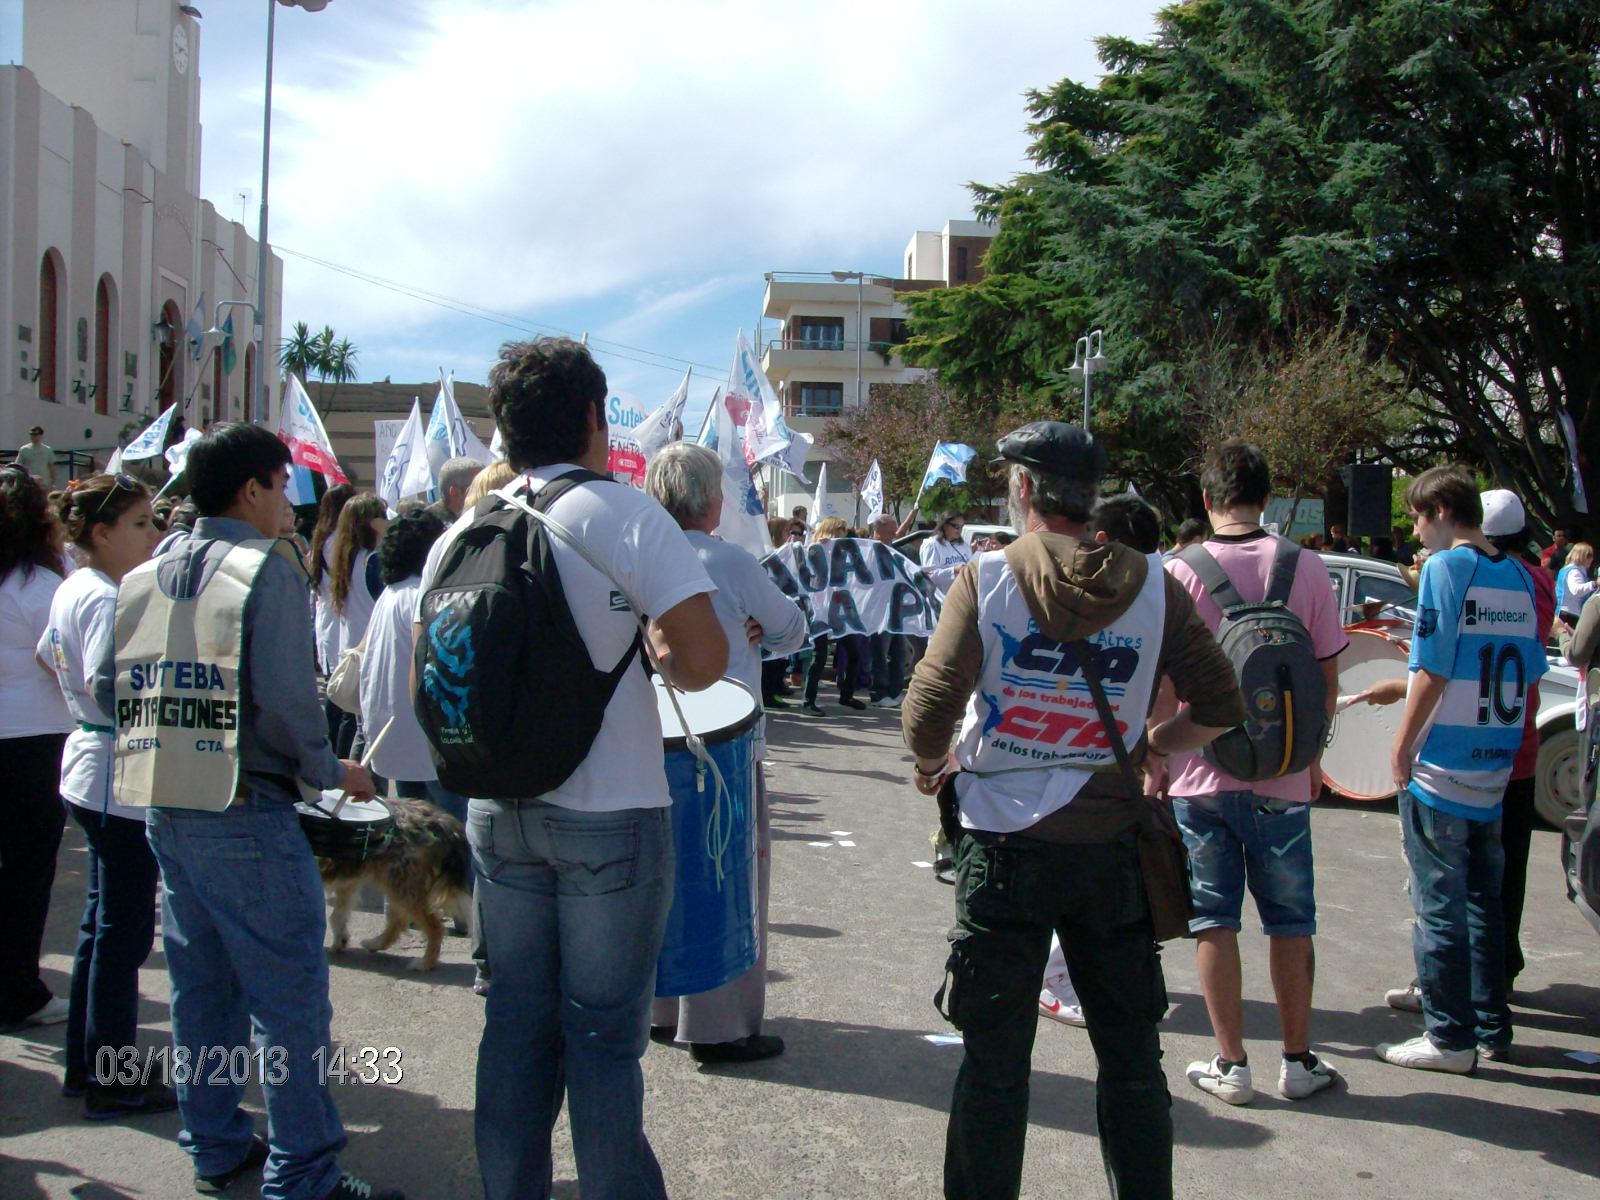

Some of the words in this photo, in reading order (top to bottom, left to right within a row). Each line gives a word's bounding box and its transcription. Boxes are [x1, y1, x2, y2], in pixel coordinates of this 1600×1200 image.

[1097, 630, 1142, 649] Aires
[130, 661, 225, 691] SUTEBA
[1477, 642, 1526, 725] 10
[1003, 686, 1015, 697] de
[1018, 689, 1037, 700] los
[118, 696, 237, 731] PATAGONES
[995, 705, 1129, 749] CTA
[196, 740, 225, 753] CTA
[992, 738, 1007, 751] de
[1009, 741, 1029, 757] los
